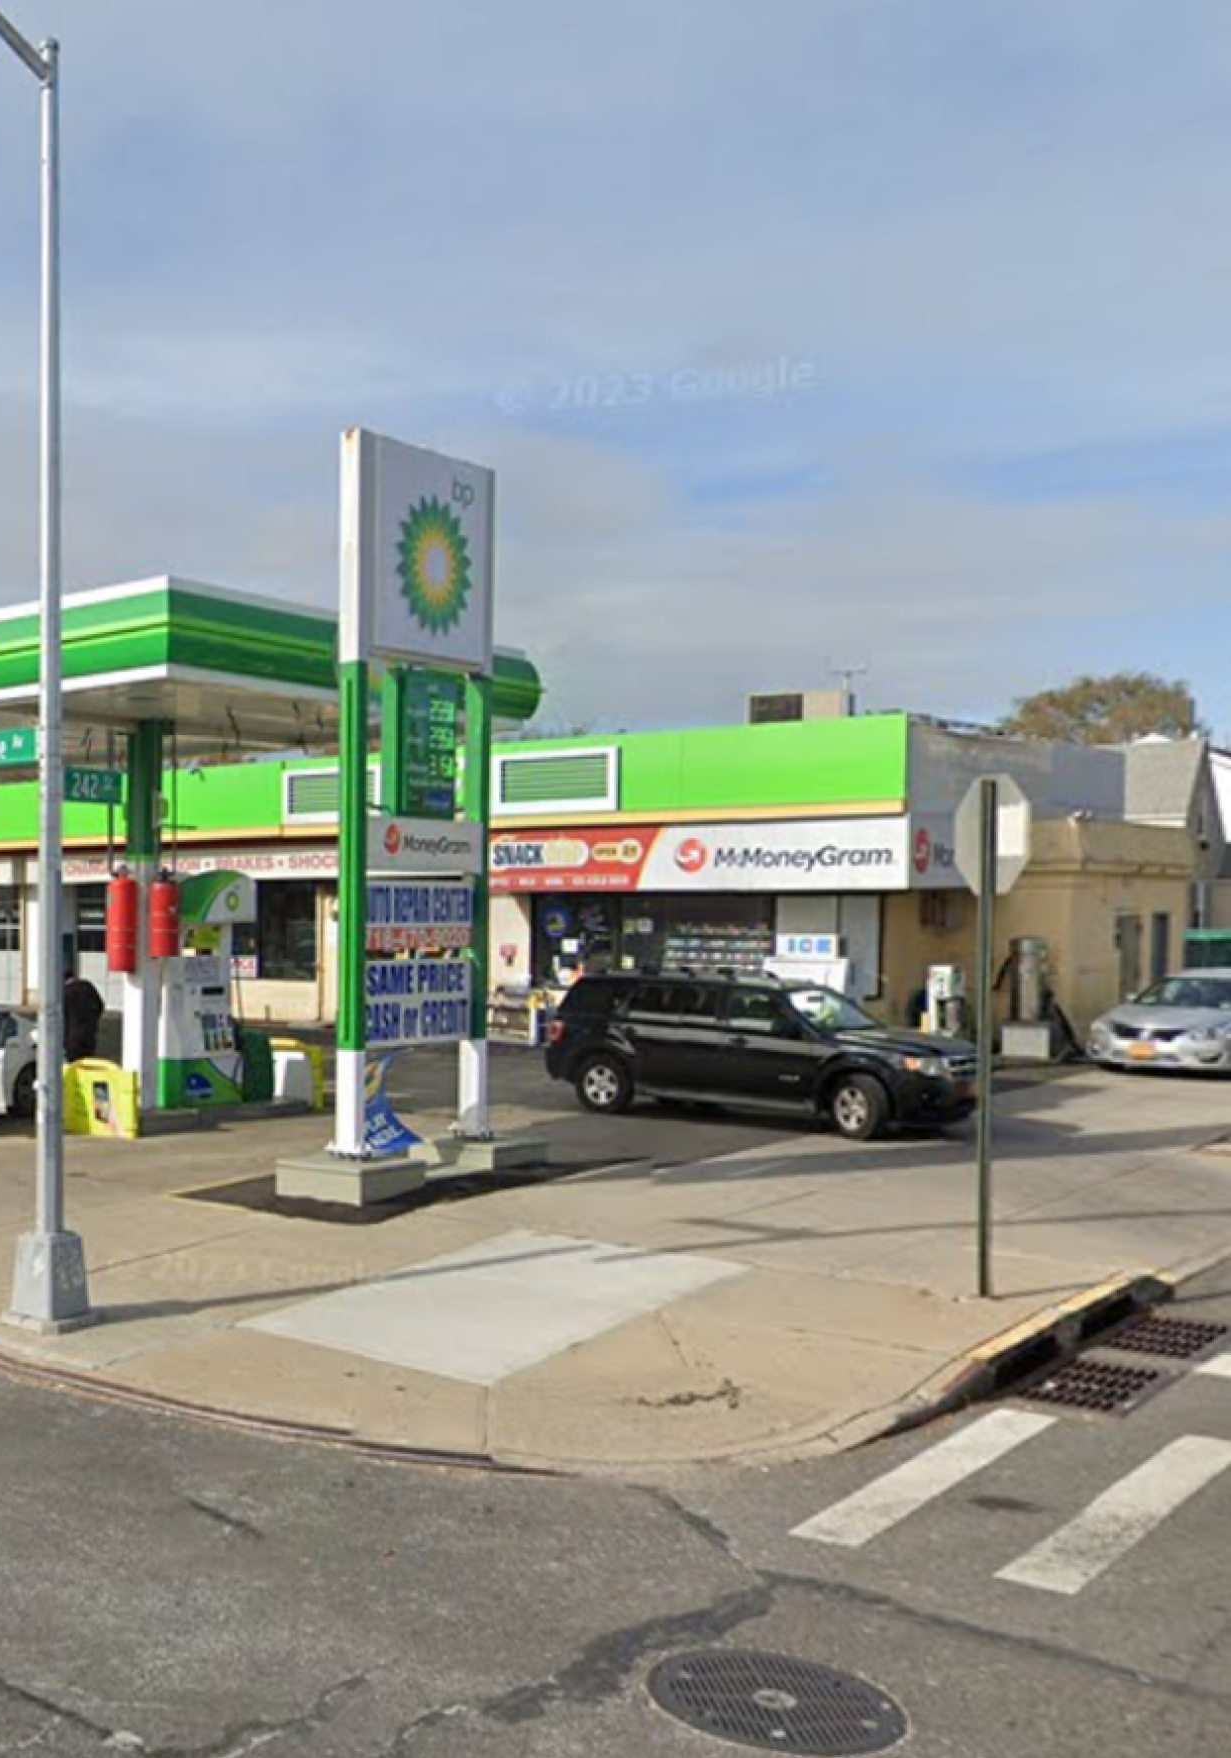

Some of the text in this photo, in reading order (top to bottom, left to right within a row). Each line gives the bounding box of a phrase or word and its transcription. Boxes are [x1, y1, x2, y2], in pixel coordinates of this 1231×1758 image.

[452, 473, 475, 509] bp
[72, 772, 99, 798] 242
[403, 835, 470, 857] MoneyGram
[492, 843, 544, 866] SNACK
[215, 854, 274, 871] BRAKES
[288, 851, 338, 868] SHOC
[393, 886, 430, 923] REPAIR
[433, 886, 470, 923] CENTER
[787, 938, 833, 954] ICE
[366, 962, 465, 996] SAME PRICE
[422, 999, 468, 1036] CREDIT
